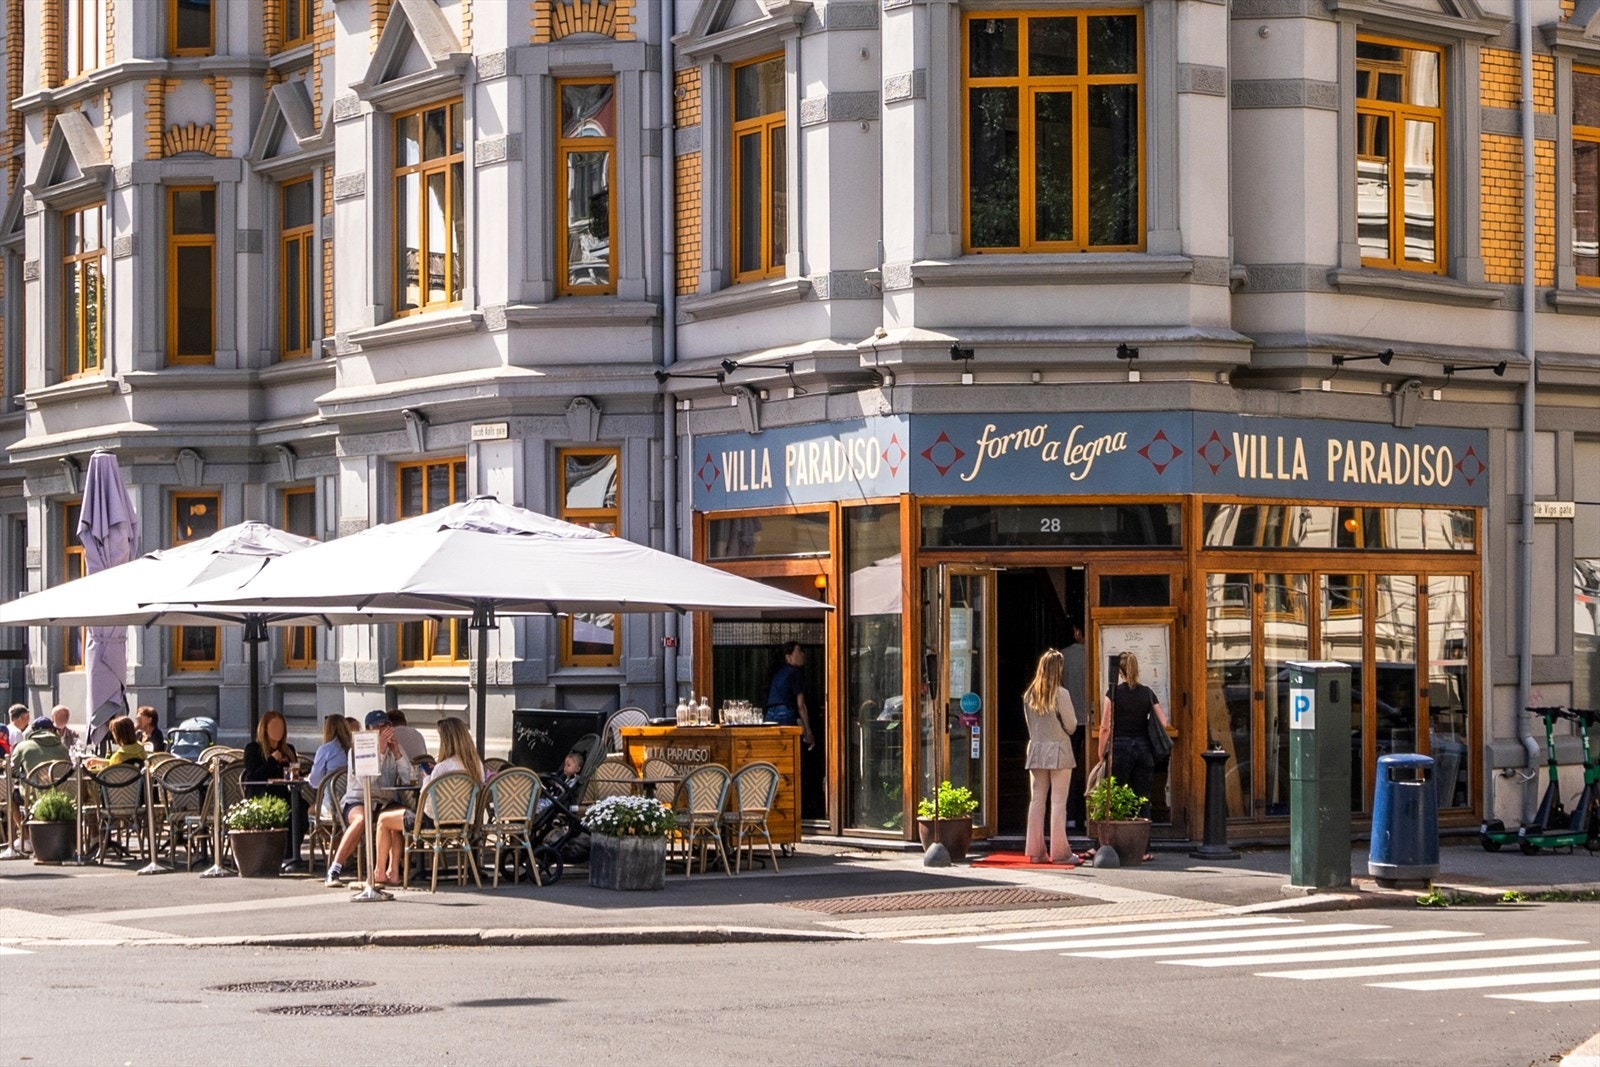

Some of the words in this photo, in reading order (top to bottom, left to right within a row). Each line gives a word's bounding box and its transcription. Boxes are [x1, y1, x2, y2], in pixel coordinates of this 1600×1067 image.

[722, 447, 772, 493] VILLA
[785, 436, 881, 487] PARADISO
[960, 423, 1048, 482] forno
[1042, 441, 1060, 462] a
[1063, 424, 1128, 481] legna
[1232, 431, 1309, 481] VILLA
[1328, 438, 1454, 488] PARADISO
[1559, 505, 1572, 516] gate
[1040, 518, 1061, 533] 28
[1295, 695, 1310, 722] P
[667, 747, 708, 762] PARADISO
